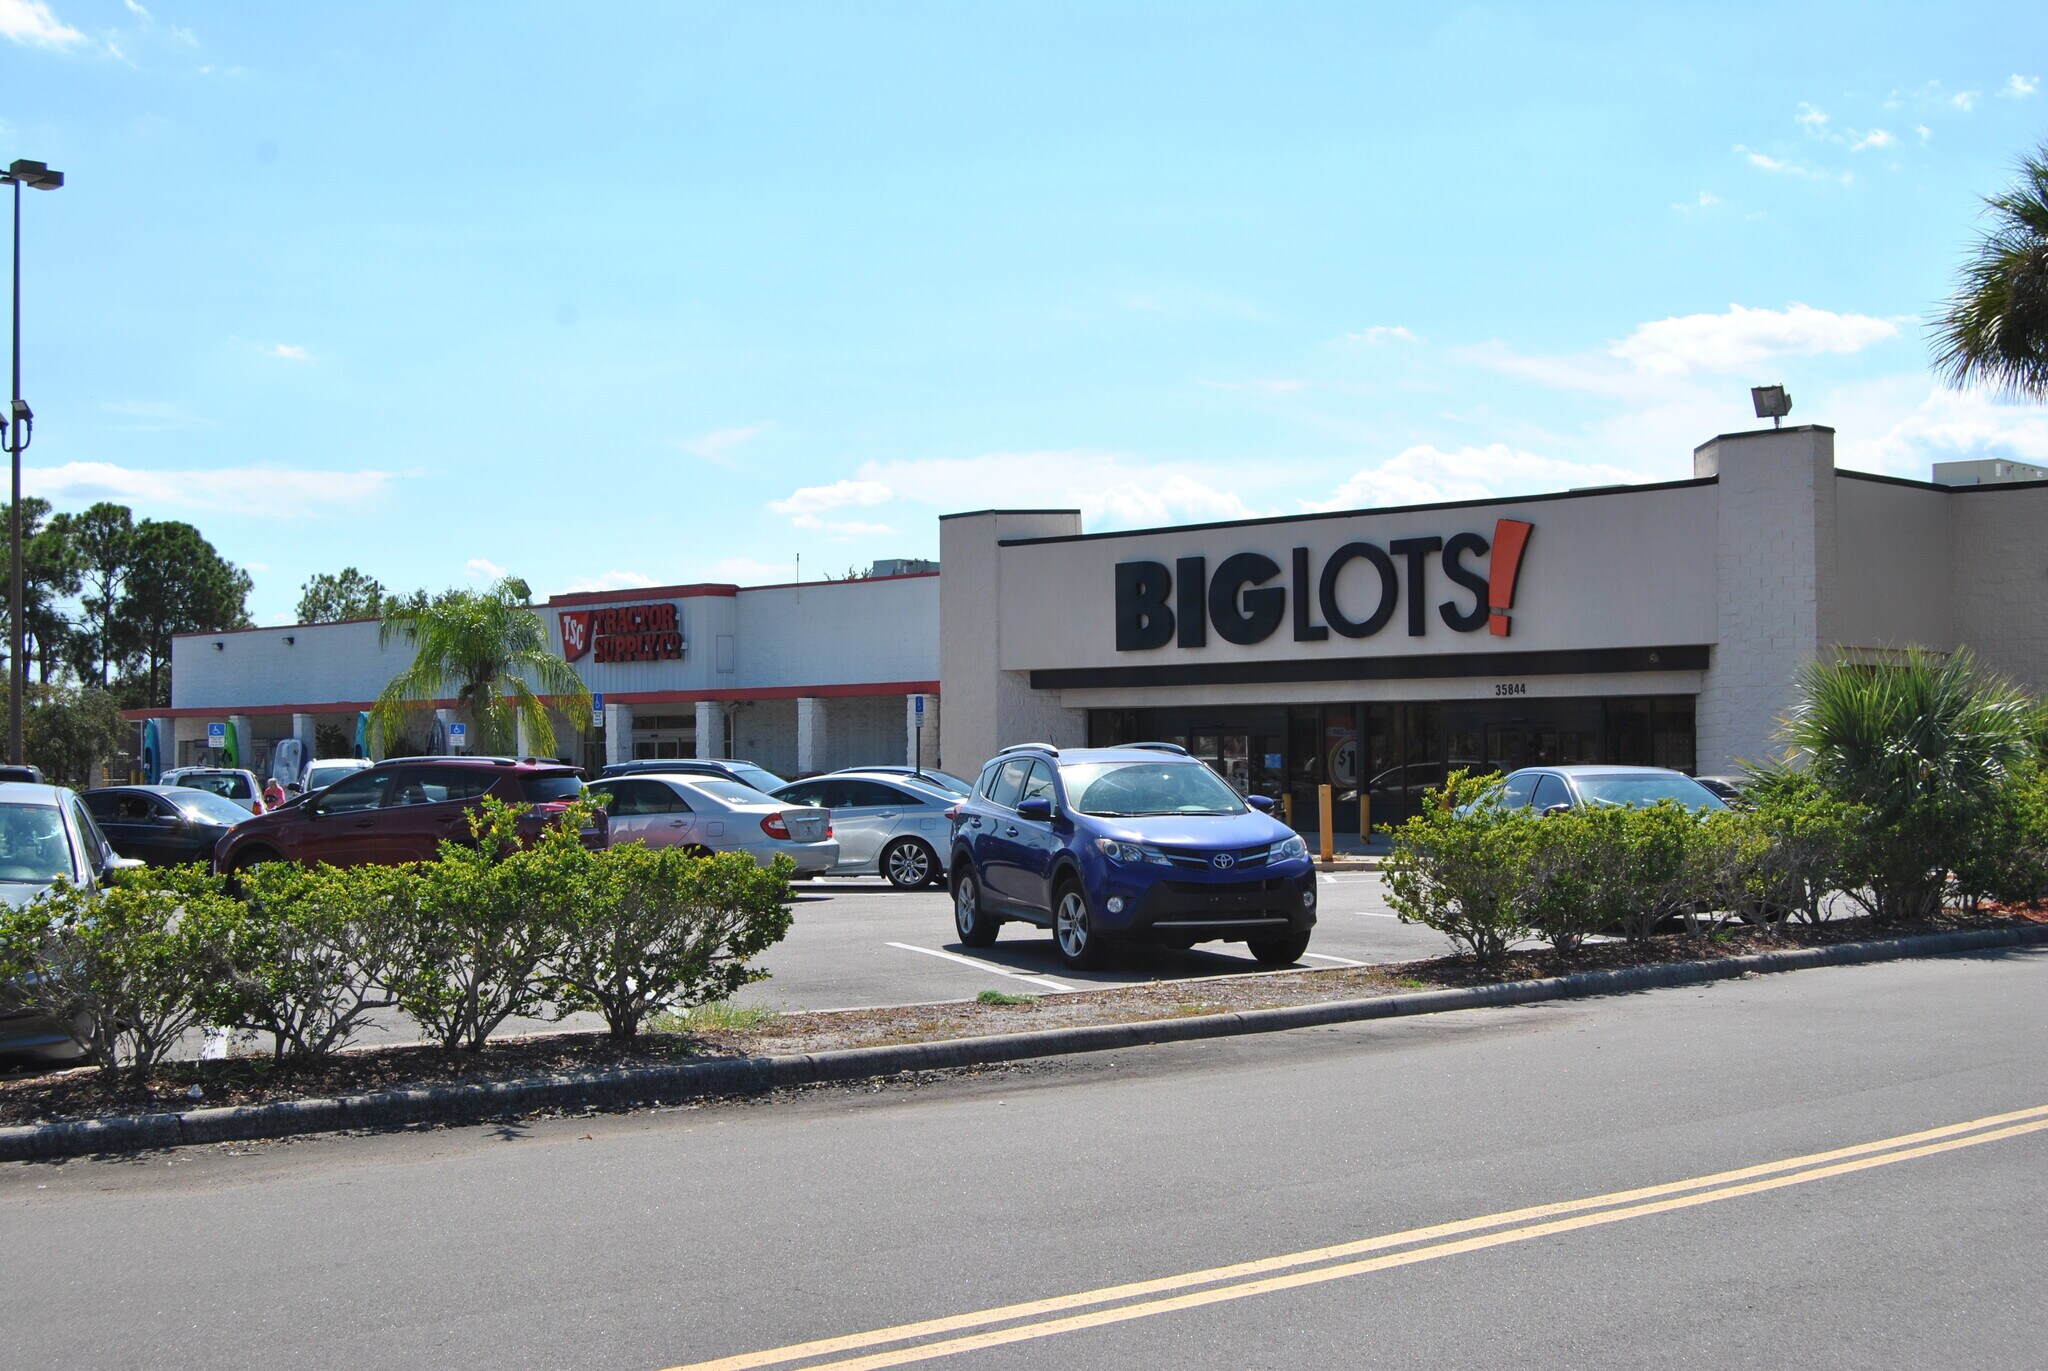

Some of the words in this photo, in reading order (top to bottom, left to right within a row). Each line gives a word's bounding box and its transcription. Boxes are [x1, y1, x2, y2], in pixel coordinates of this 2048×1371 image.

[1115, 552, 1285, 651] BIG
[1292, 518, 1535, 642] LOTS!
[563, 615, 583, 650] TSC
[594, 603, 677, 635] TRACTOR
[594, 633, 657, 663] SUPPLY
[1495, 683, 1526, 696] 35844
